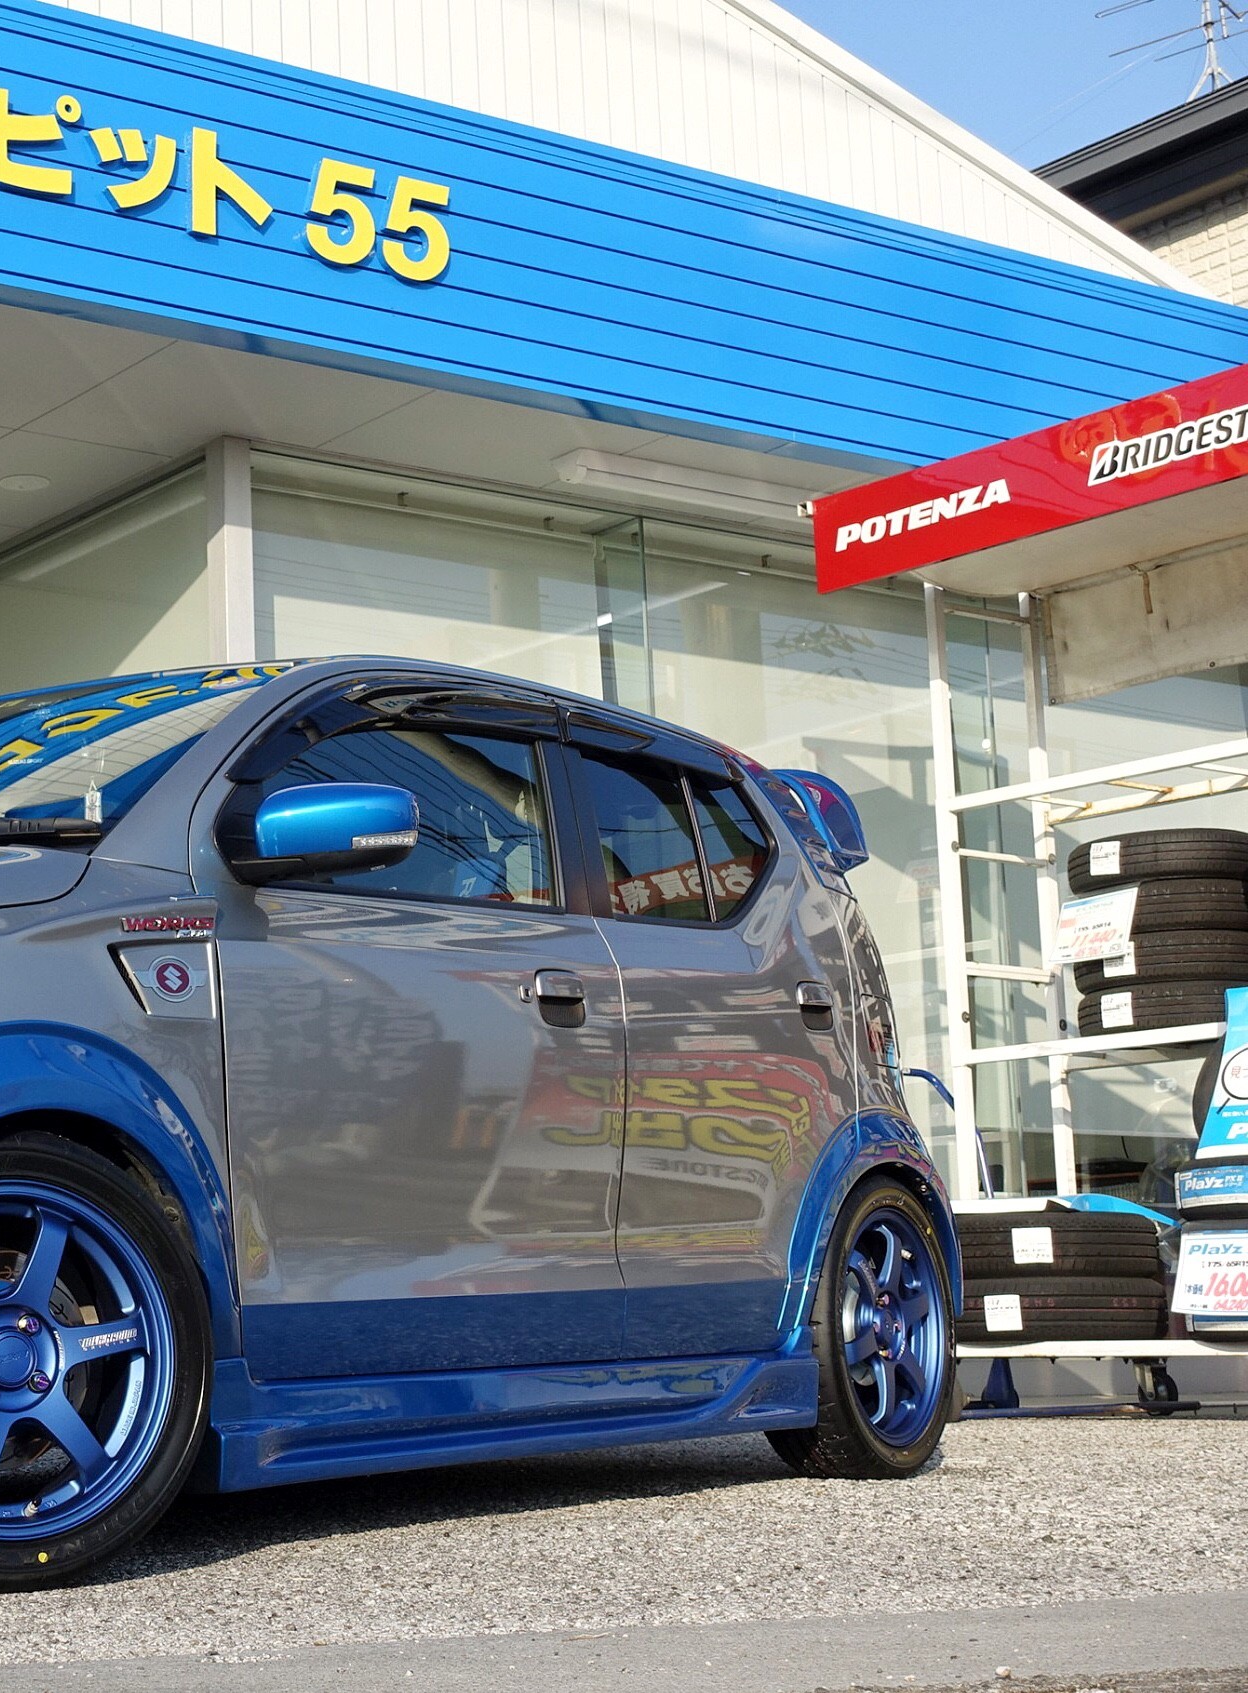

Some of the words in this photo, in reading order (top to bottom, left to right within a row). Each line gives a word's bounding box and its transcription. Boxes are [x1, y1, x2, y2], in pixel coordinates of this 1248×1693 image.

[306, 158, 450, 283] 55
[835, 478, 1011, 552] POTENZA
[121, 916, 214, 931] WORKS
